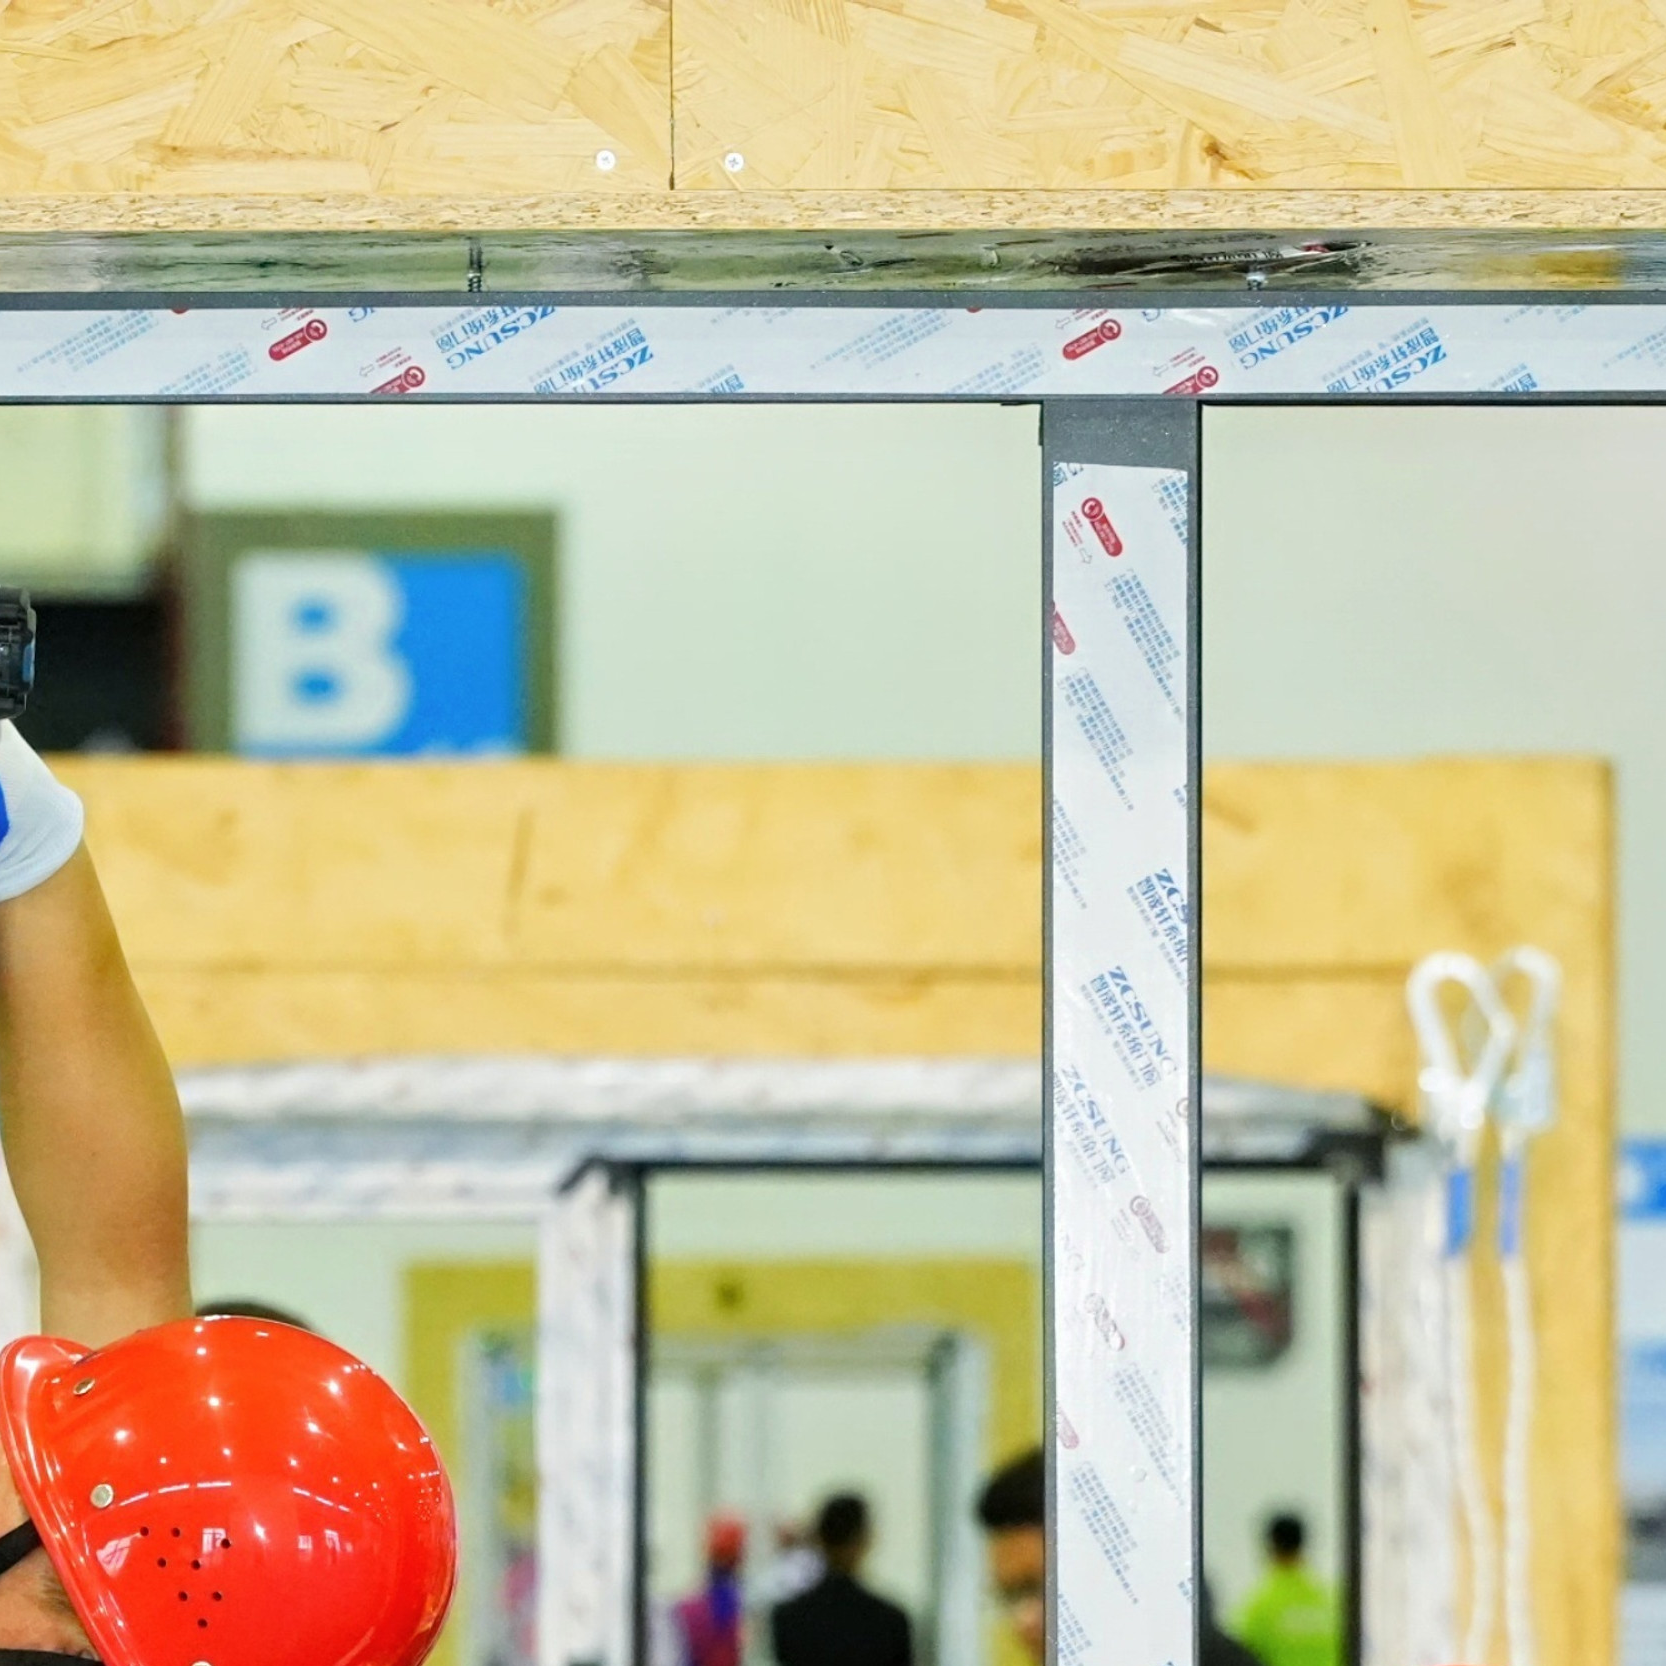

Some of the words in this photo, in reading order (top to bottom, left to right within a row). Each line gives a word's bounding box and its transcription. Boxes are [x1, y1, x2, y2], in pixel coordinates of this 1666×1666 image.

[574, 340, 654, 393] ZCSU
[1369, 344, 1447, 393] ZCSU
[232, 553, 413, 750] B
[1108, 966, 1177, 1075] ZCSUNG
